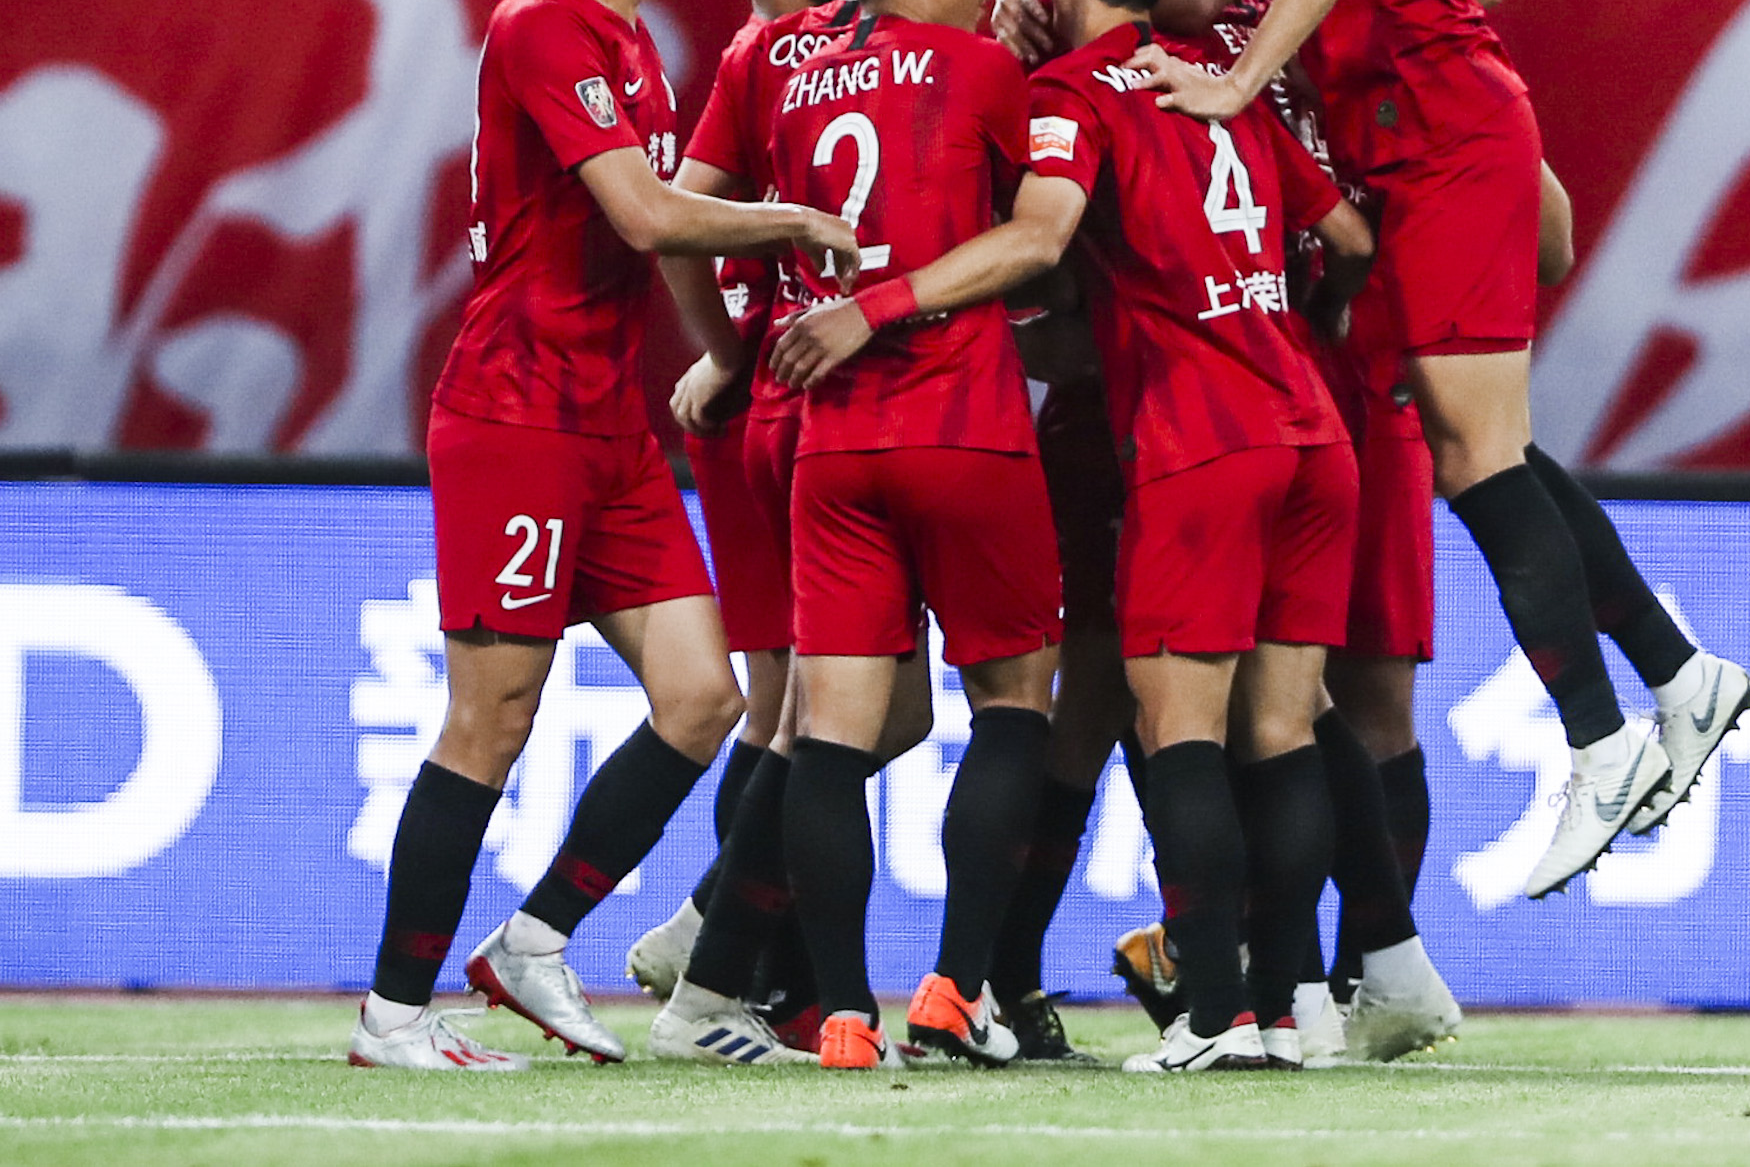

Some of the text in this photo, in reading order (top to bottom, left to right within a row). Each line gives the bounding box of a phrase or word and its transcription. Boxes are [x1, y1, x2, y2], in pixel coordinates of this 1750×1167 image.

[781, 49, 935, 114] ZHANG W.
[812, 111, 891, 277] 2
[1203, 119, 1268, 254] 4
[495, 514, 563, 589] 21
